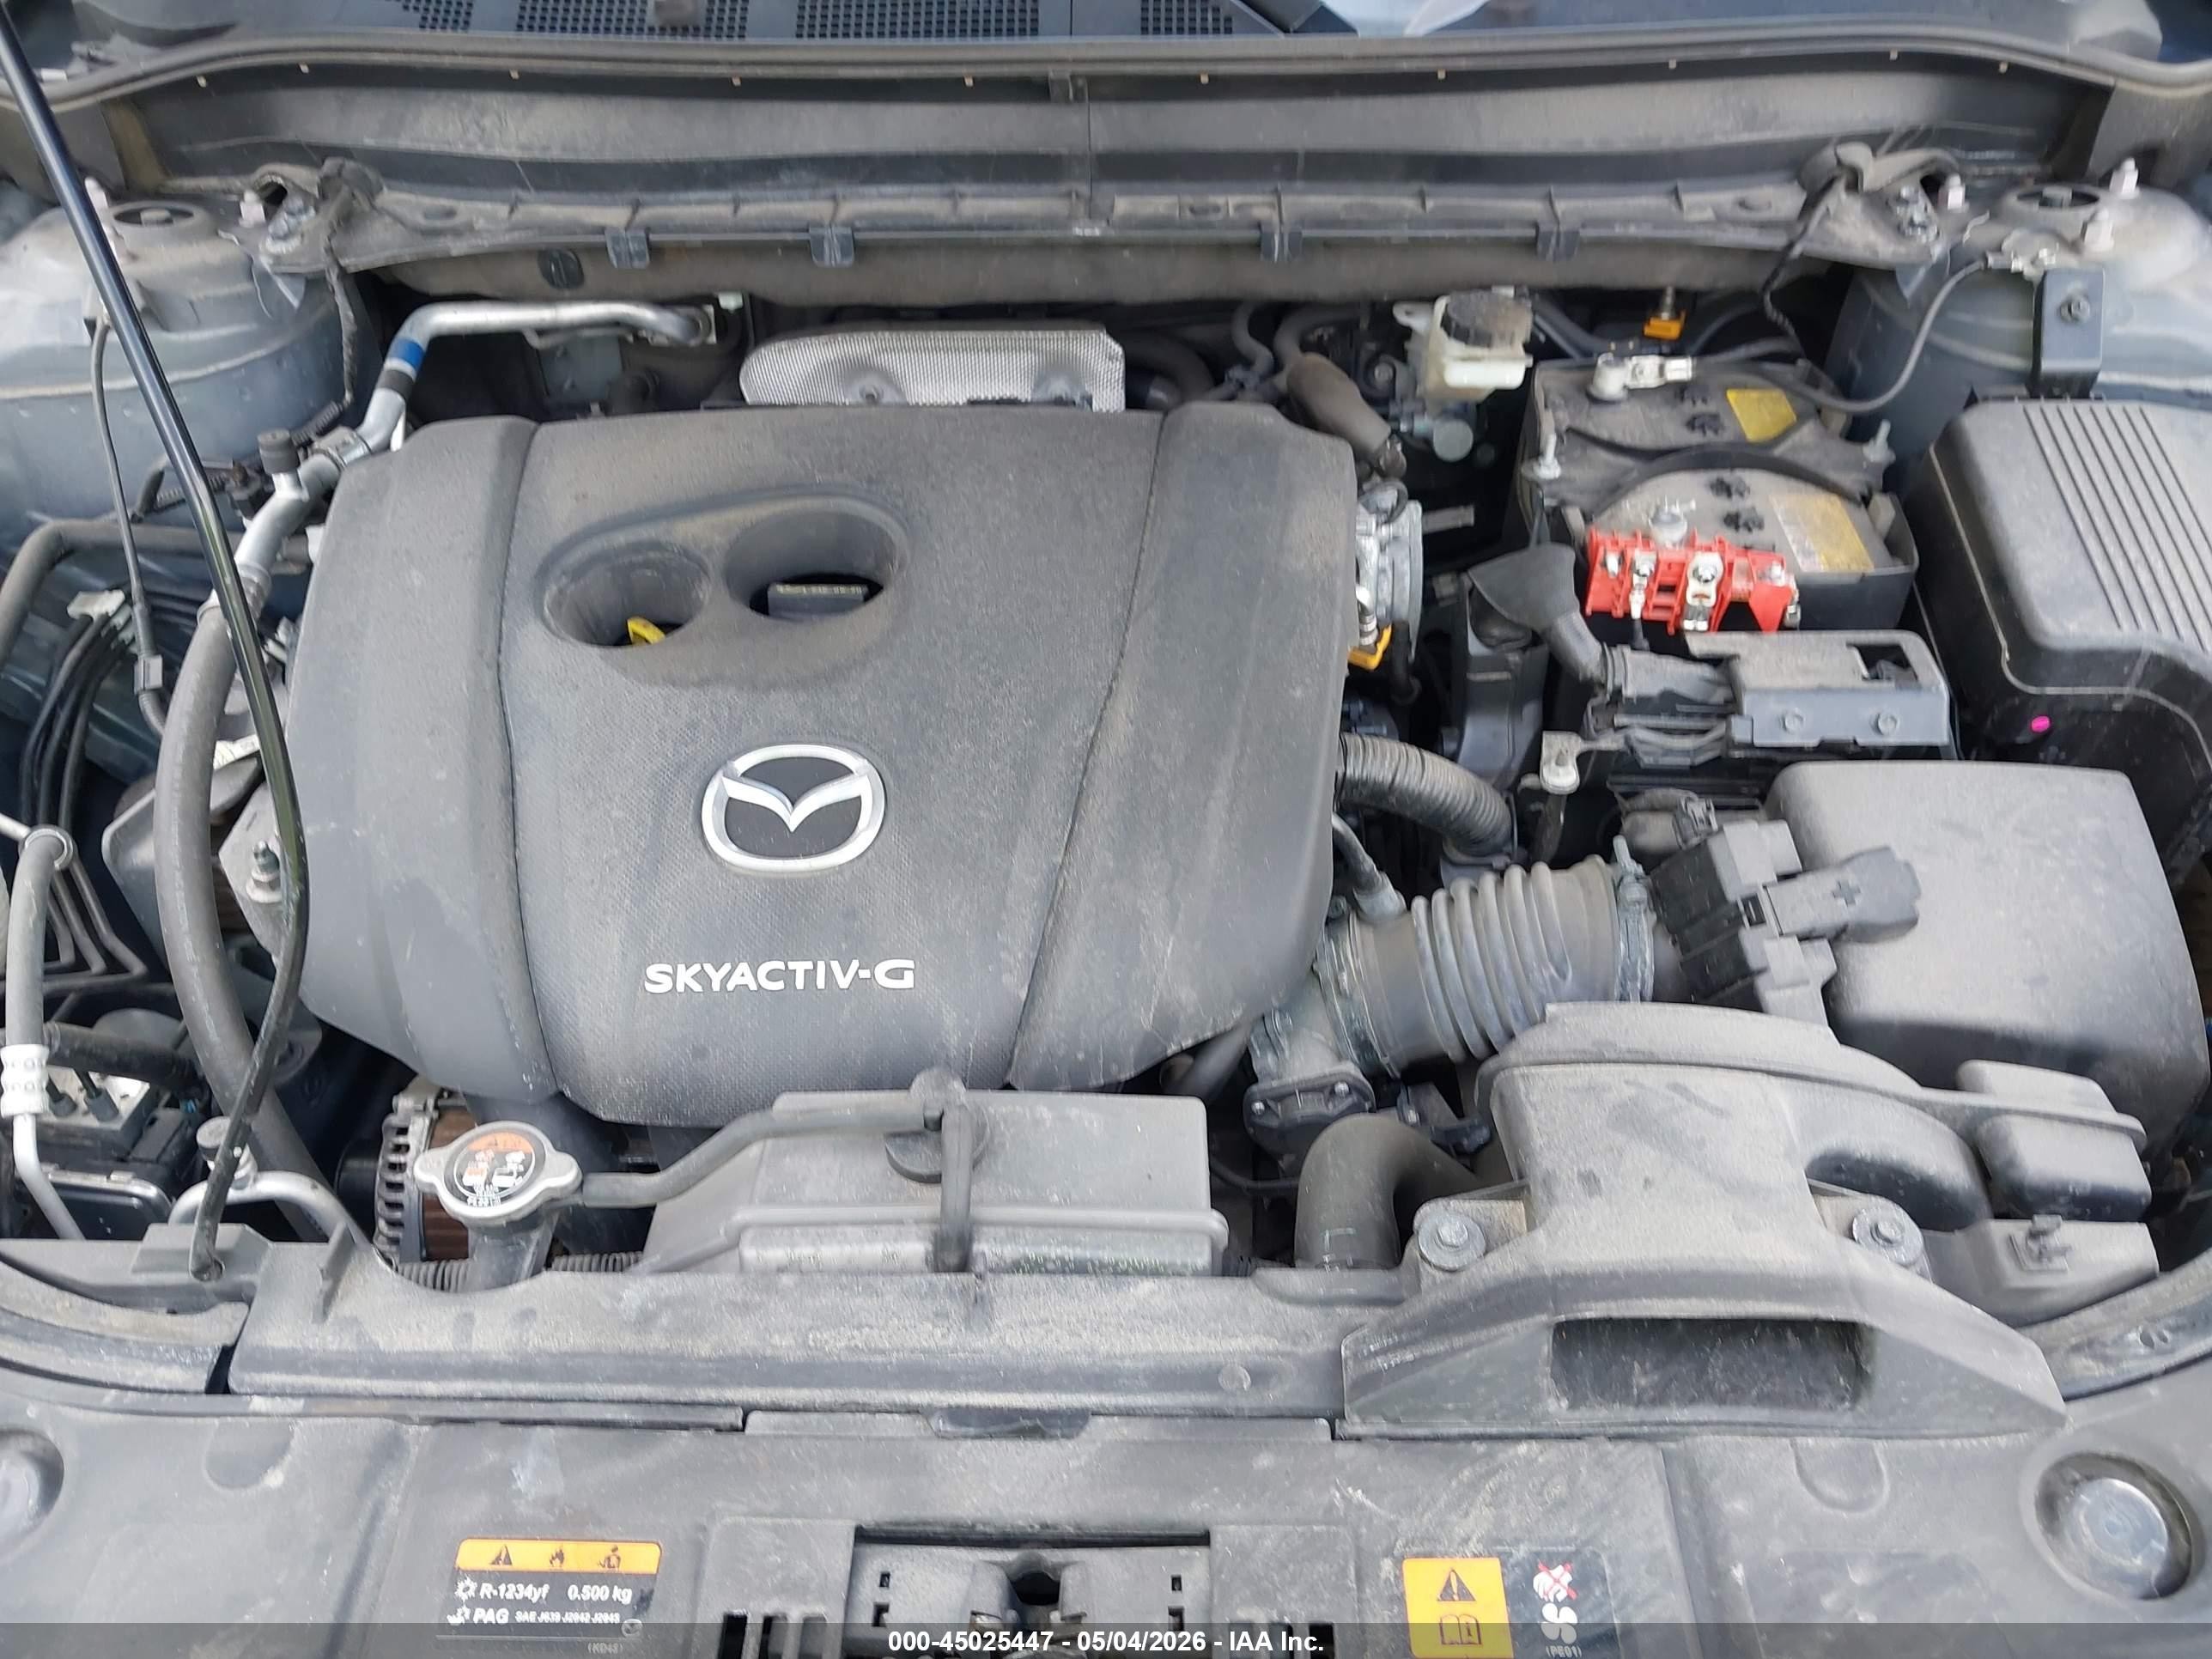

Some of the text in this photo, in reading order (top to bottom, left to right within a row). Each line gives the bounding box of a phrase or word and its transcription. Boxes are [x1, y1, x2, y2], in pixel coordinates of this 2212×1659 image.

[644, 958, 915, 994] SKYACTIV-G
[479, 1583, 633, 1605] R-1234yf 0.500 kg
[473, 1607, 509, 1624] PAG
[514, 1611, 537, 1623] SAE
